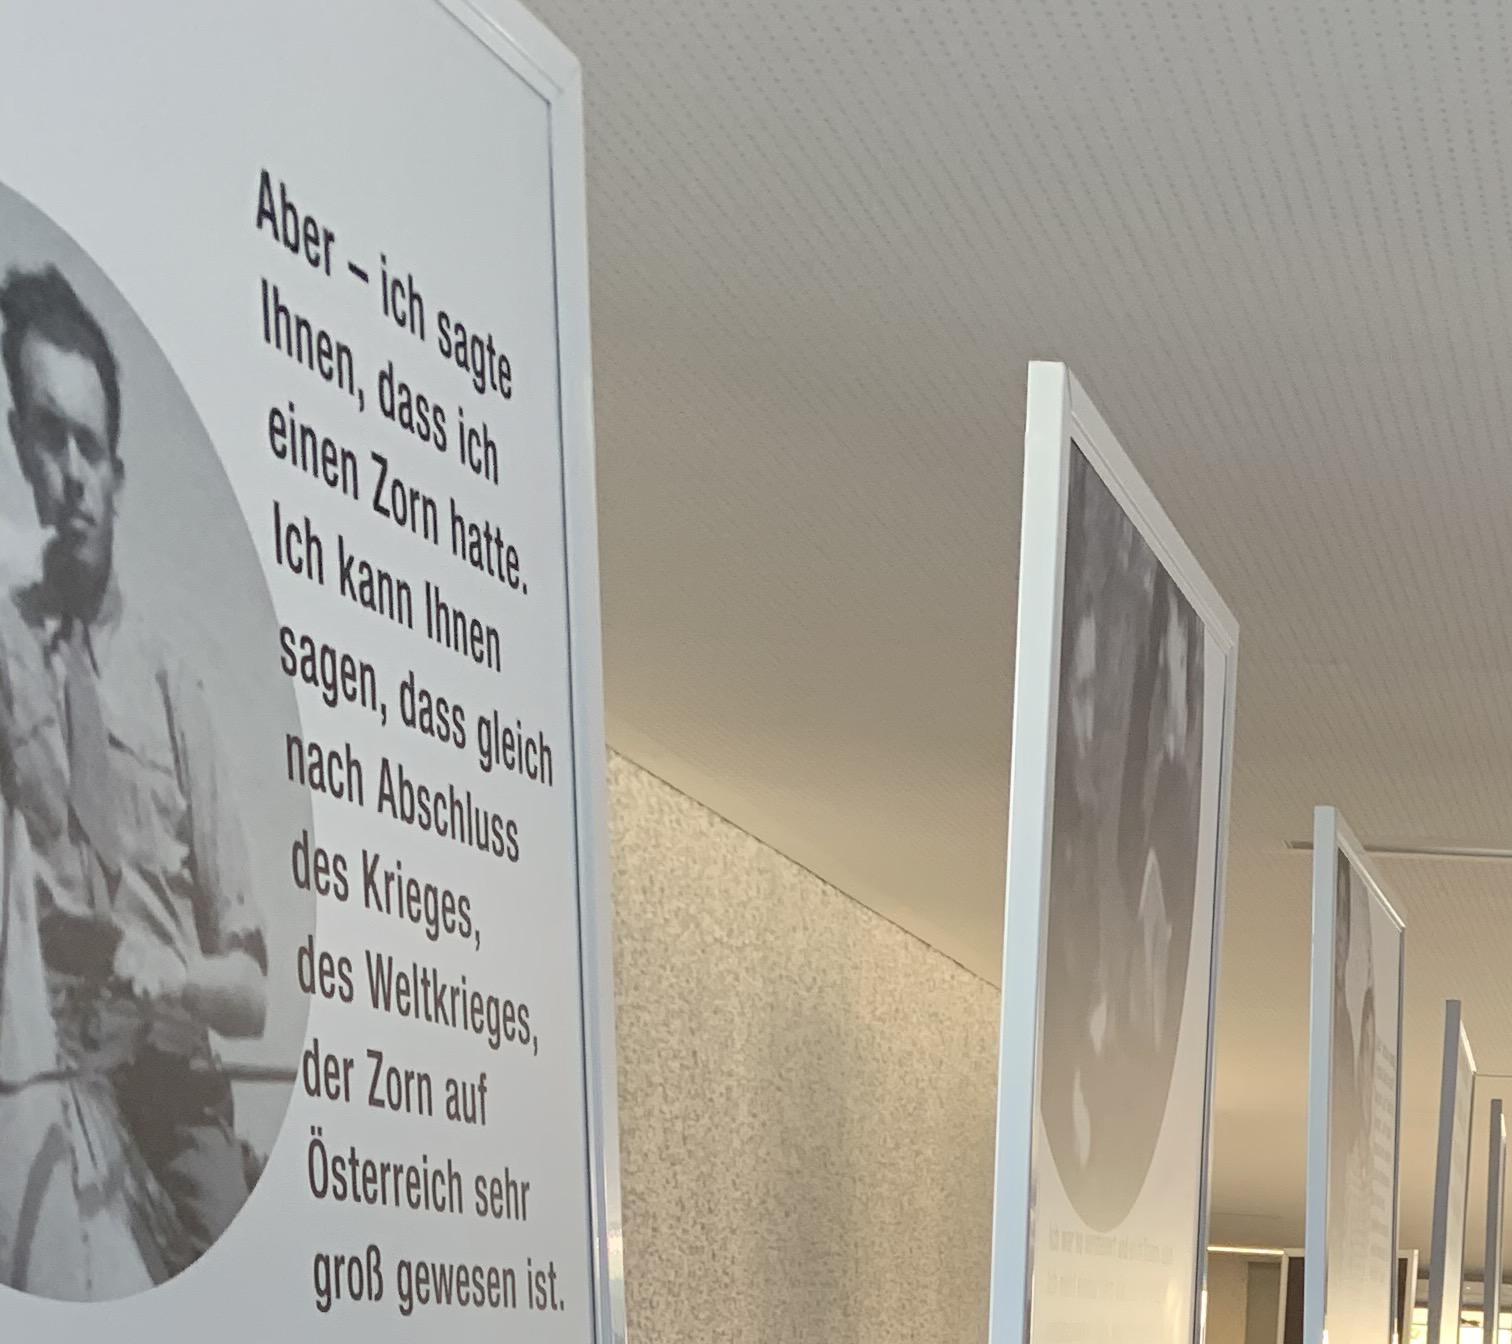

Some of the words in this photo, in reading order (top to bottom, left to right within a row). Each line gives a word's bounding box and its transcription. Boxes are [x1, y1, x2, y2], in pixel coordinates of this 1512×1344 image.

[256, 169, 336, 276] Aber
[380, 255, 426, 341] ich
[436, 308, 513, 400] sagte
[260, 279, 365, 411] Ihnen,
[378, 361, 447, 451] dass
[458, 406, 500, 485] ich
[269, 402, 359, 500] einen
[371, 451, 439, 545] Zorn
[450, 500, 529, 595] hatte.
[272, 501, 325, 585] Ich
[338, 534, 414, 629] kann
[425, 581, 502, 672] Ihnen
[279, 625, 388, 725] sagen,
[399, 672, 467, 749] dass
[477, 707, 554, 786] gleich
[286, 729, 364, 807] nach
[377, 756, 520, 862] Abschluss
[292, 829, 349, 902] des
[362, 849, 481, 951] Krieges,
[298, 935, 354, 1003] des
[366, 949, 539, 1056] Weltkrieges,
[303, 1039, 354, 1101] der
[367, 1049, 433, 1117] Zorn
[446, 1073, 488, 1126] auf
[307, 1126, 463, 1214] Österreich
[475, 1167, 530, 1221] sehr
[313, 1244, 383, 1313] groß
[398, 1258, 517, 1316] gewesen
[527, 1258, 564, 1311] ist.
